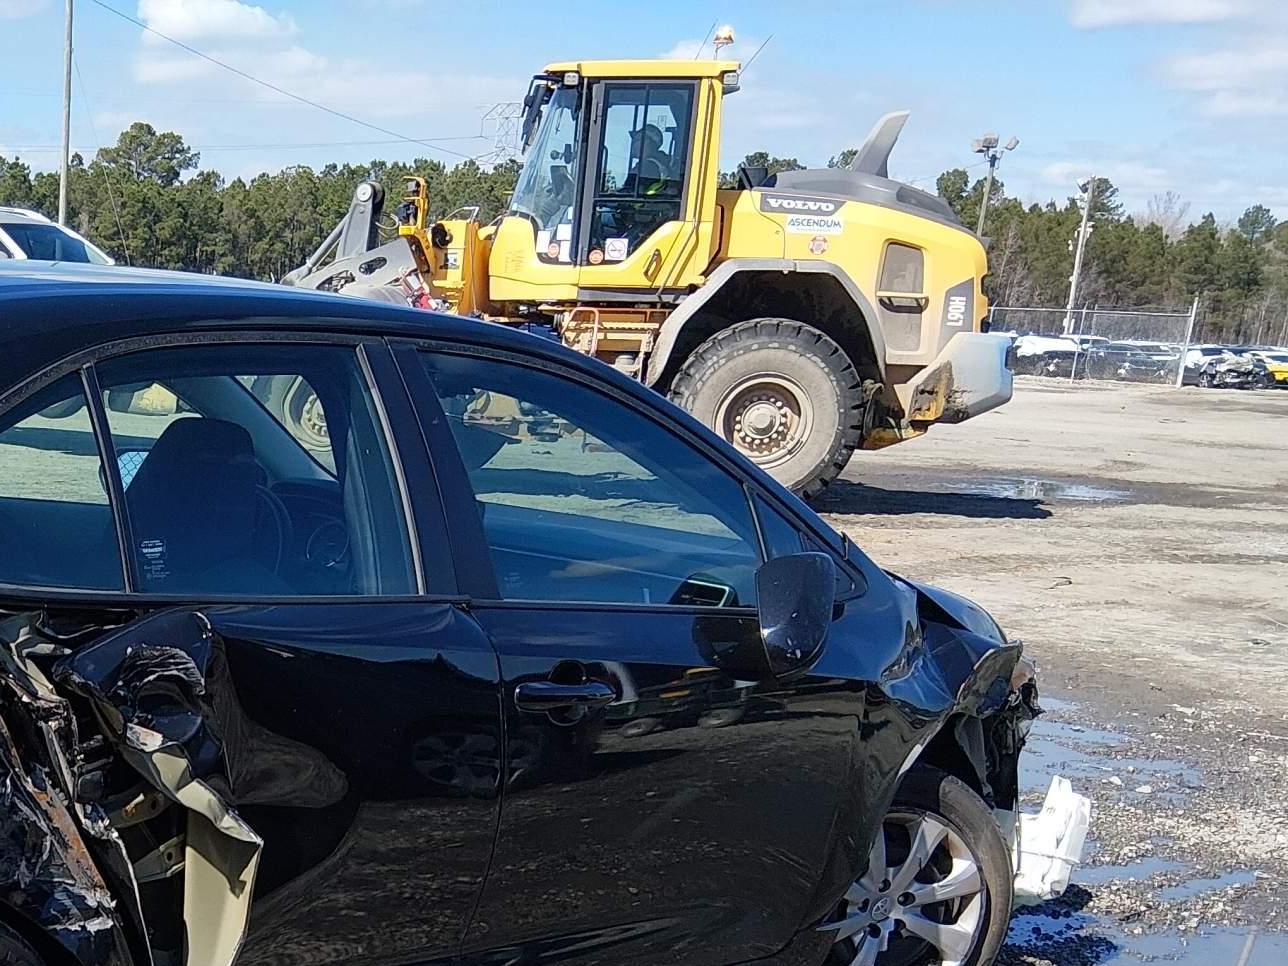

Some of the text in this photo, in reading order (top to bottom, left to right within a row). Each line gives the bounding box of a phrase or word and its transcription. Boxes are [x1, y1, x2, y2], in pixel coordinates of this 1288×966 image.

[766, 198, 835, 212] VOLVO
[787, 217, 842, 229] ASCENDUM
[946, 296, 967, 327] L90H
